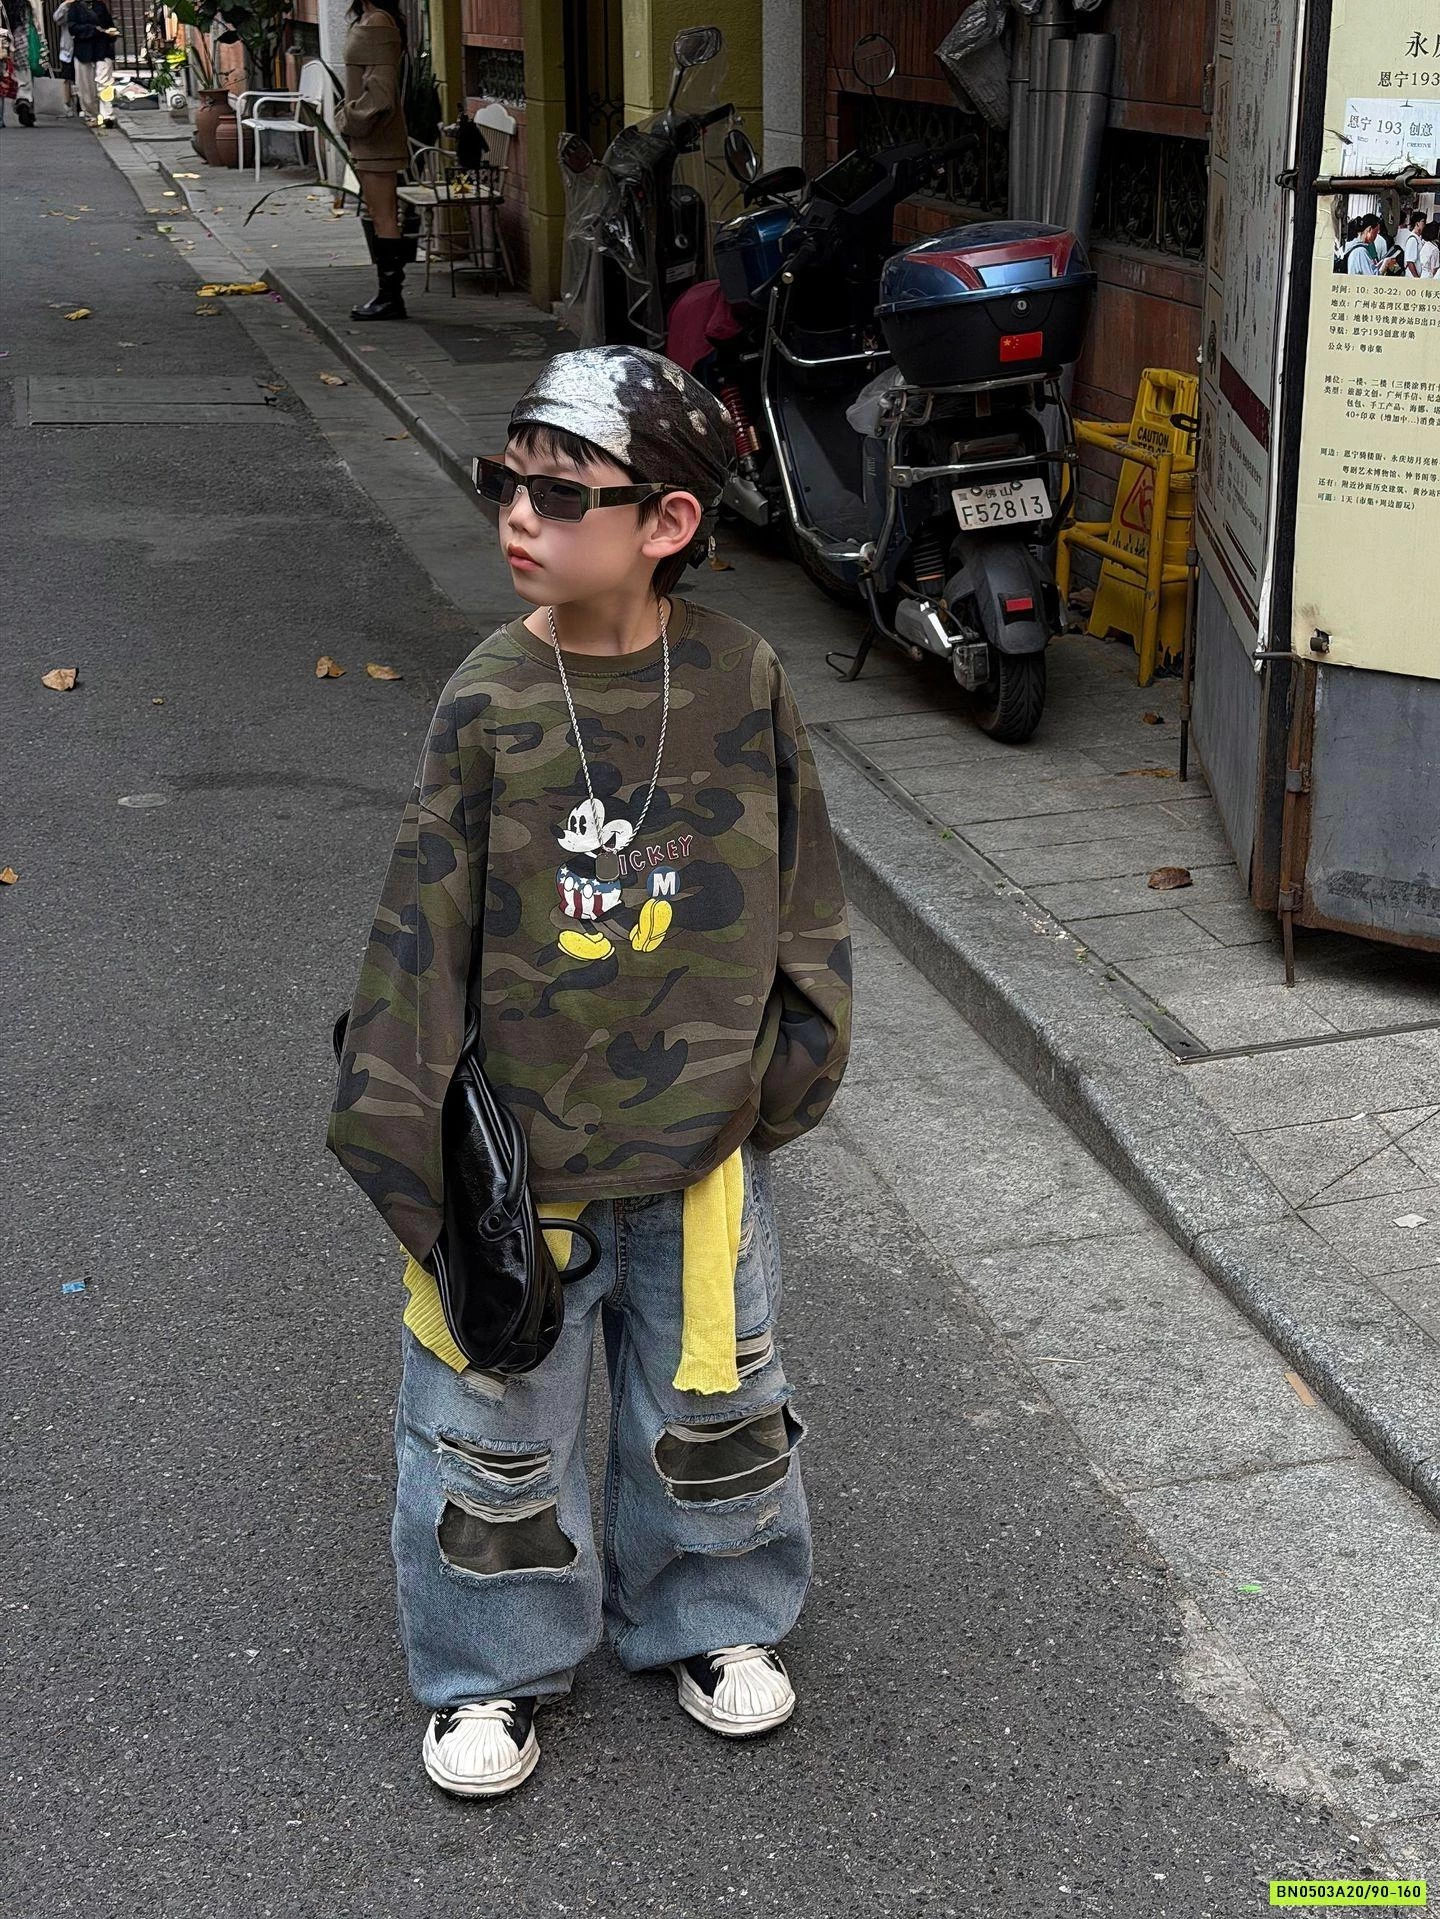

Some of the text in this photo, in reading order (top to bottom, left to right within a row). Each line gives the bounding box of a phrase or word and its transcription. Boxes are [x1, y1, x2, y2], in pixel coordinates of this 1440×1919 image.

[1378, 71, 1440, 88] 恩宁193
[1347, 114, 1433, 137] 恩宁 193 创意
[1137, 426, 1170, 449] CAUTION
[985, 486, 1013, 499] 佛山
[961, 495, 1044, 525] F52813
[618, 834, 693, 876] ICKEY
[652, 871, 676, 897] M
